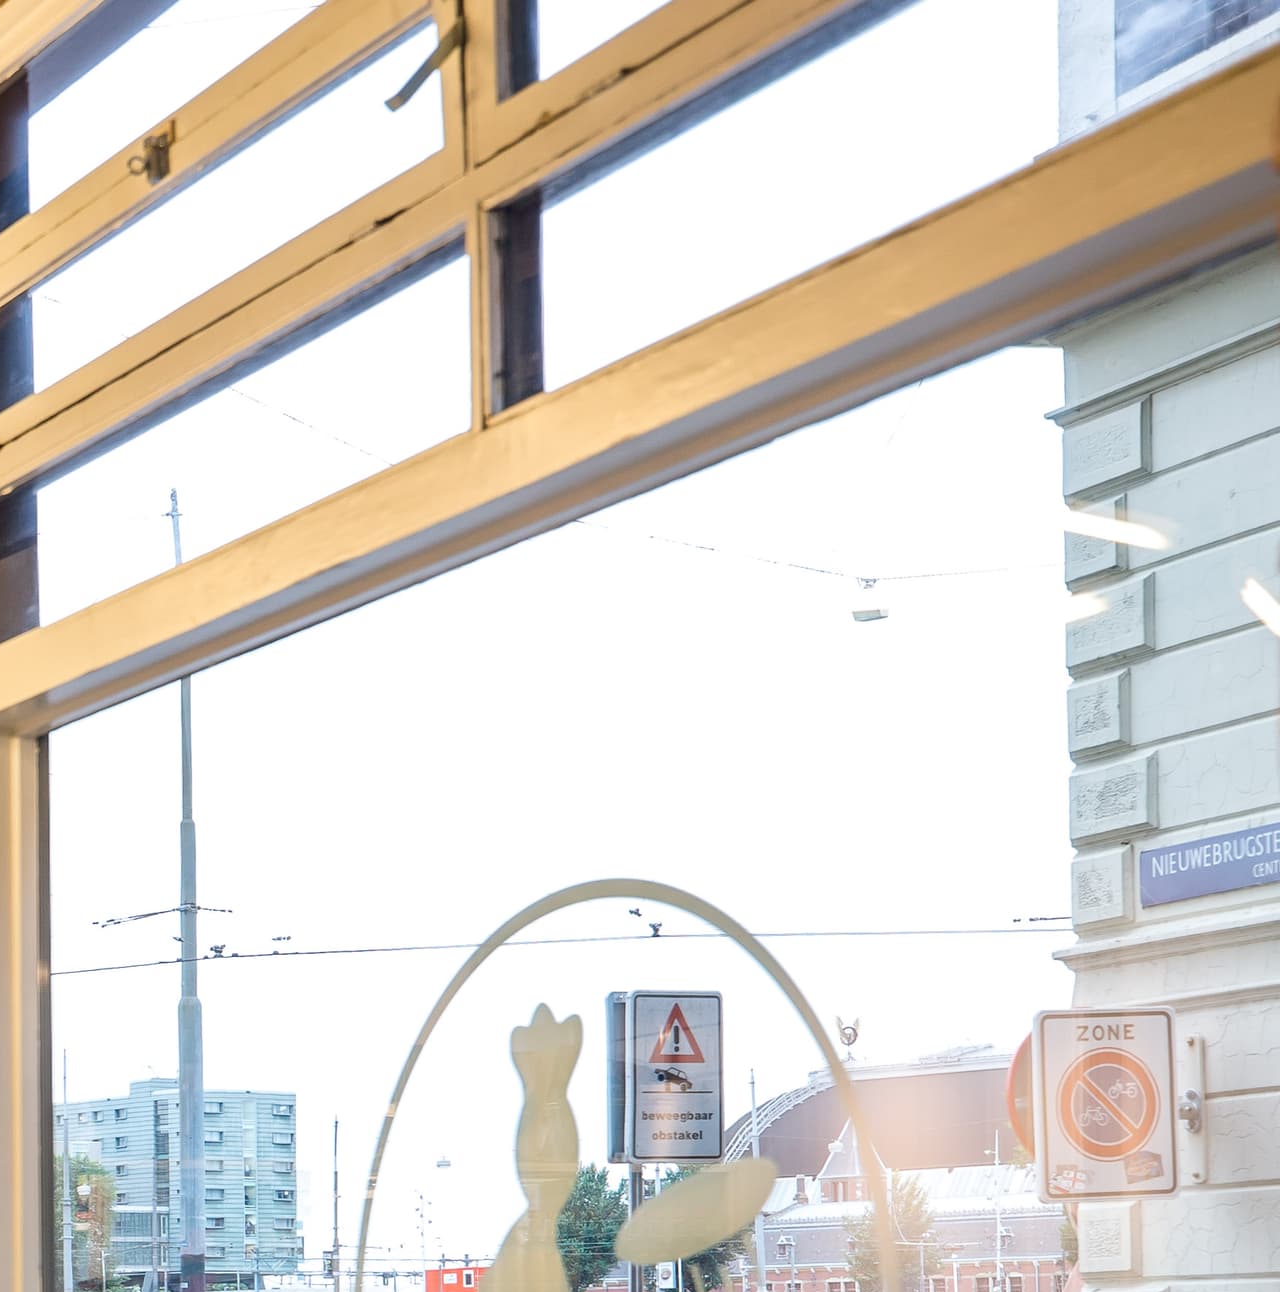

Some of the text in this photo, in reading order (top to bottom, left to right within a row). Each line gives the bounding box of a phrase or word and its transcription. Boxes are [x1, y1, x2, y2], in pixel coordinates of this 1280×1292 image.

[1076, 1023, 1135, 1042] ZONE
[642, 1110, 714, 1123] beweegbaar
[651, 1130, 703, 1141] obstakel
